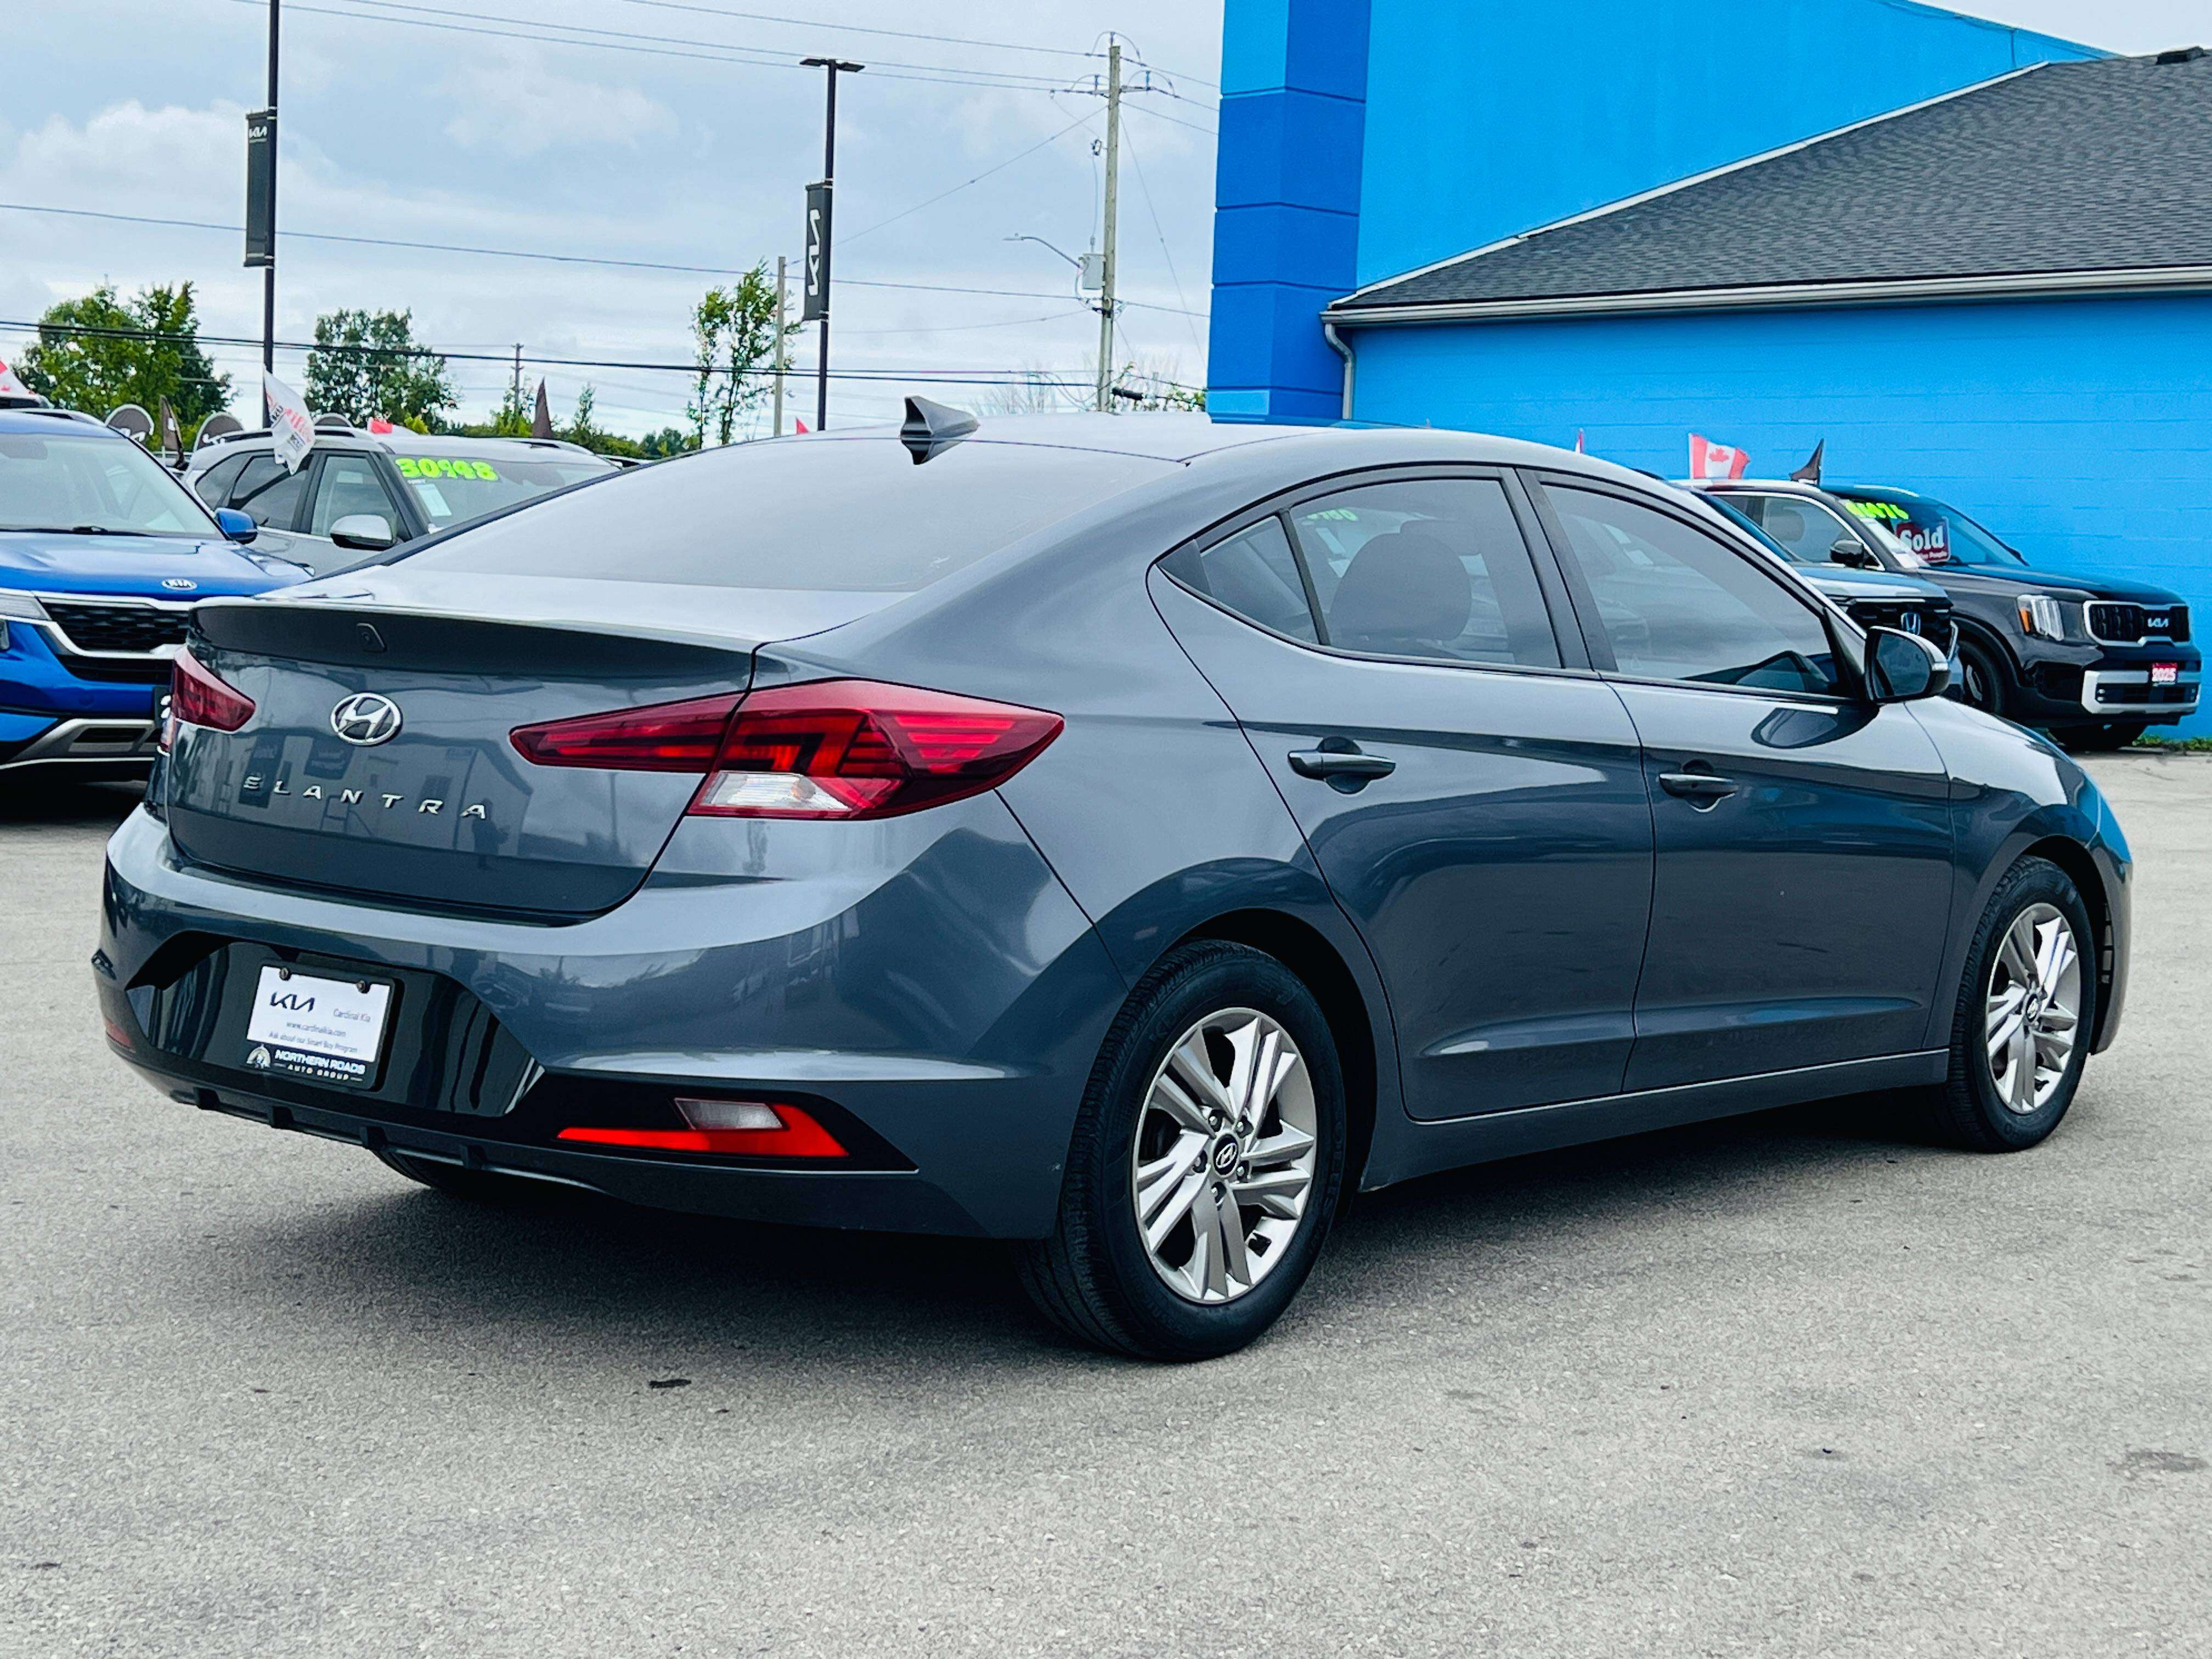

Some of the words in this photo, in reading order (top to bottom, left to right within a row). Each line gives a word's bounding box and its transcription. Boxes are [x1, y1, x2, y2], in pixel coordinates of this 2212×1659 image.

[249, 126, 267, 138] KIA
[1900, 525, 1945, 552] Sold
[2147, 617, 2169, 628] KIA
[2152, 667, 2177, 682] 2025
[243, 775, 487, 820] ELANTRA
[269, 991, 315, 1012] KIA
[333, 1008, 359, 1020] Cardinal
[275, 1049, 330, 1068] NORTHERN
[287, 1064, 313, 1075] AUTO
[317, 1069, 349, 1081] GROUP
